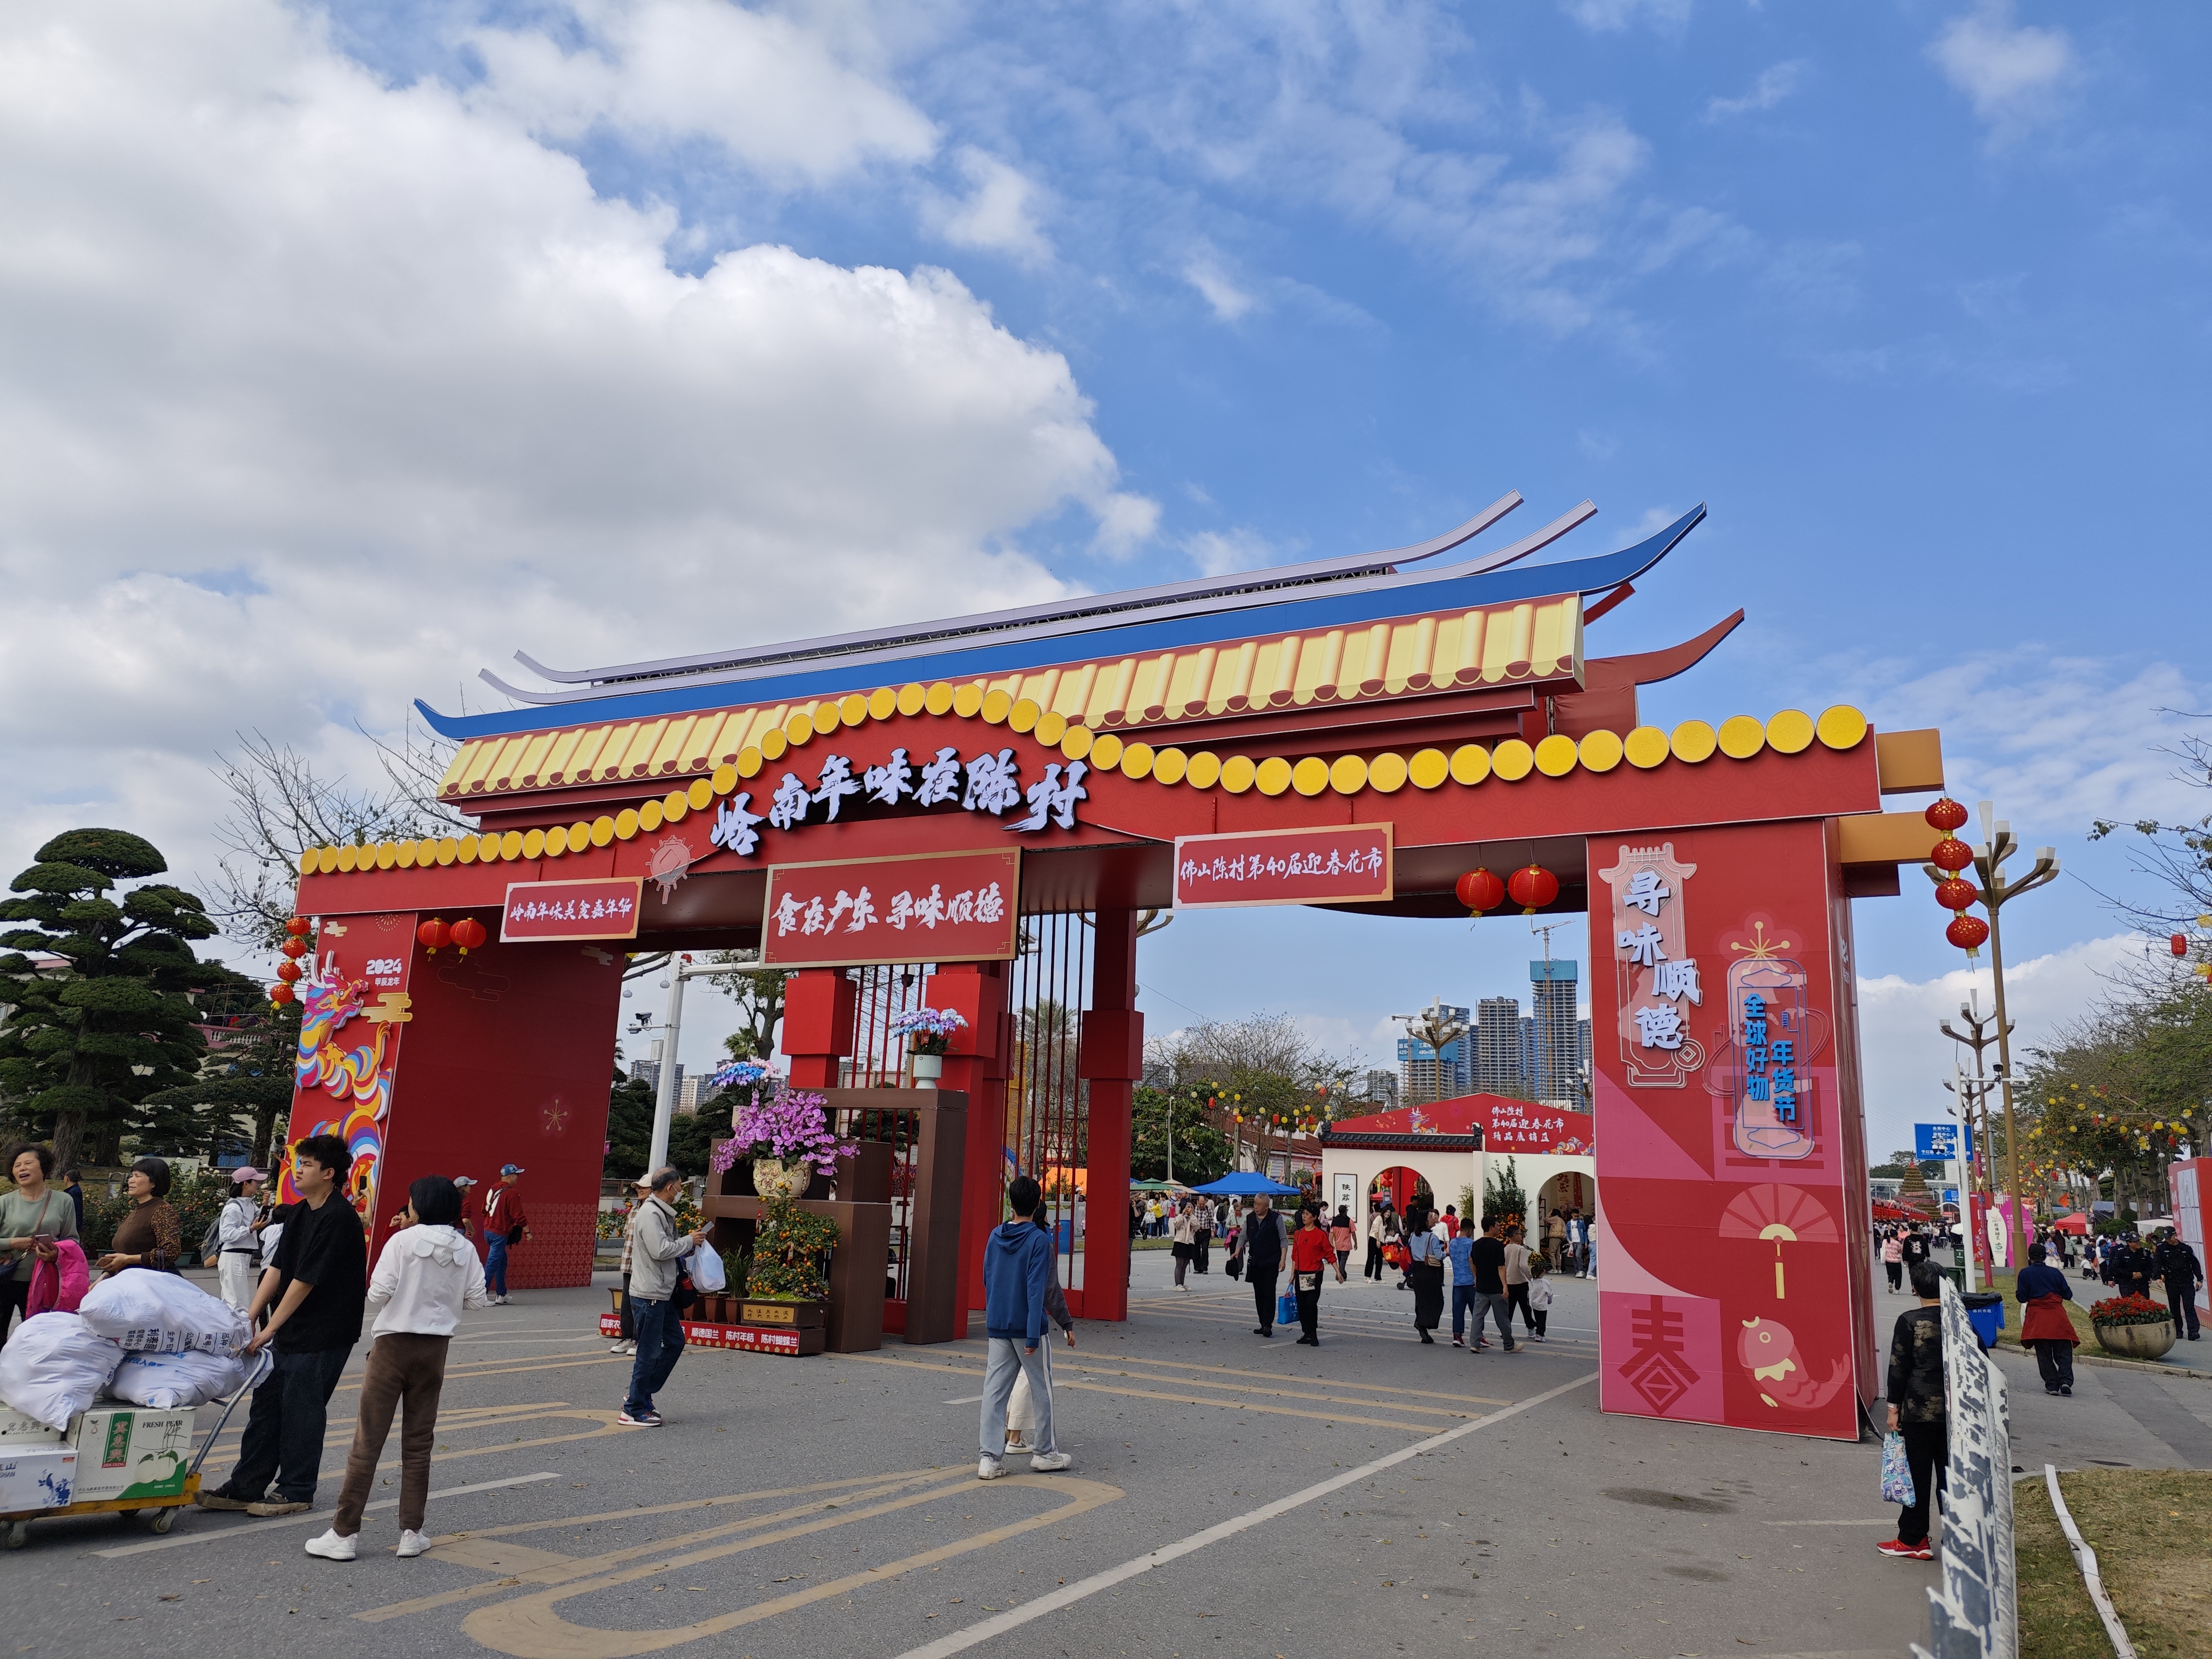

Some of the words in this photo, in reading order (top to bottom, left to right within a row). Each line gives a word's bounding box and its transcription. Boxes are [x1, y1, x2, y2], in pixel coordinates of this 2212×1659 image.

[710, 747, 1088, 856] 岭南年味在陈村
[1180, 847, 1383, 888] 佛山陈村第40届迎春花市
[510, 897, 633, 922] 岭南年味美食嘉年华
[771, 886, 879, 937] 食在广东
[886, 881, 1004, 930] 寻味顺德
[366, 958, 402, 975] 2024
[1617, 870, 1701, 1050] 寻味顺德
[375, 977, 401, 987] 甲辰龙年
[1743, 993, 1770, 1101] 全球好物
[1770, 1040, 1796, 1122] 年货节
[1492, 1104, 1523, 1117] 佛山陈村
[1491, 1118, 1564, 1133] 第40届迎春花市
[1492, 1131, 1550, 1142] 精品展销区
[691, 1327, 719, 1340] 顺德国兰
[725, 1330, 754, 1343] 陈村年桔
[761, 1333, 798, 1347] 陈村蝴蝶兰
